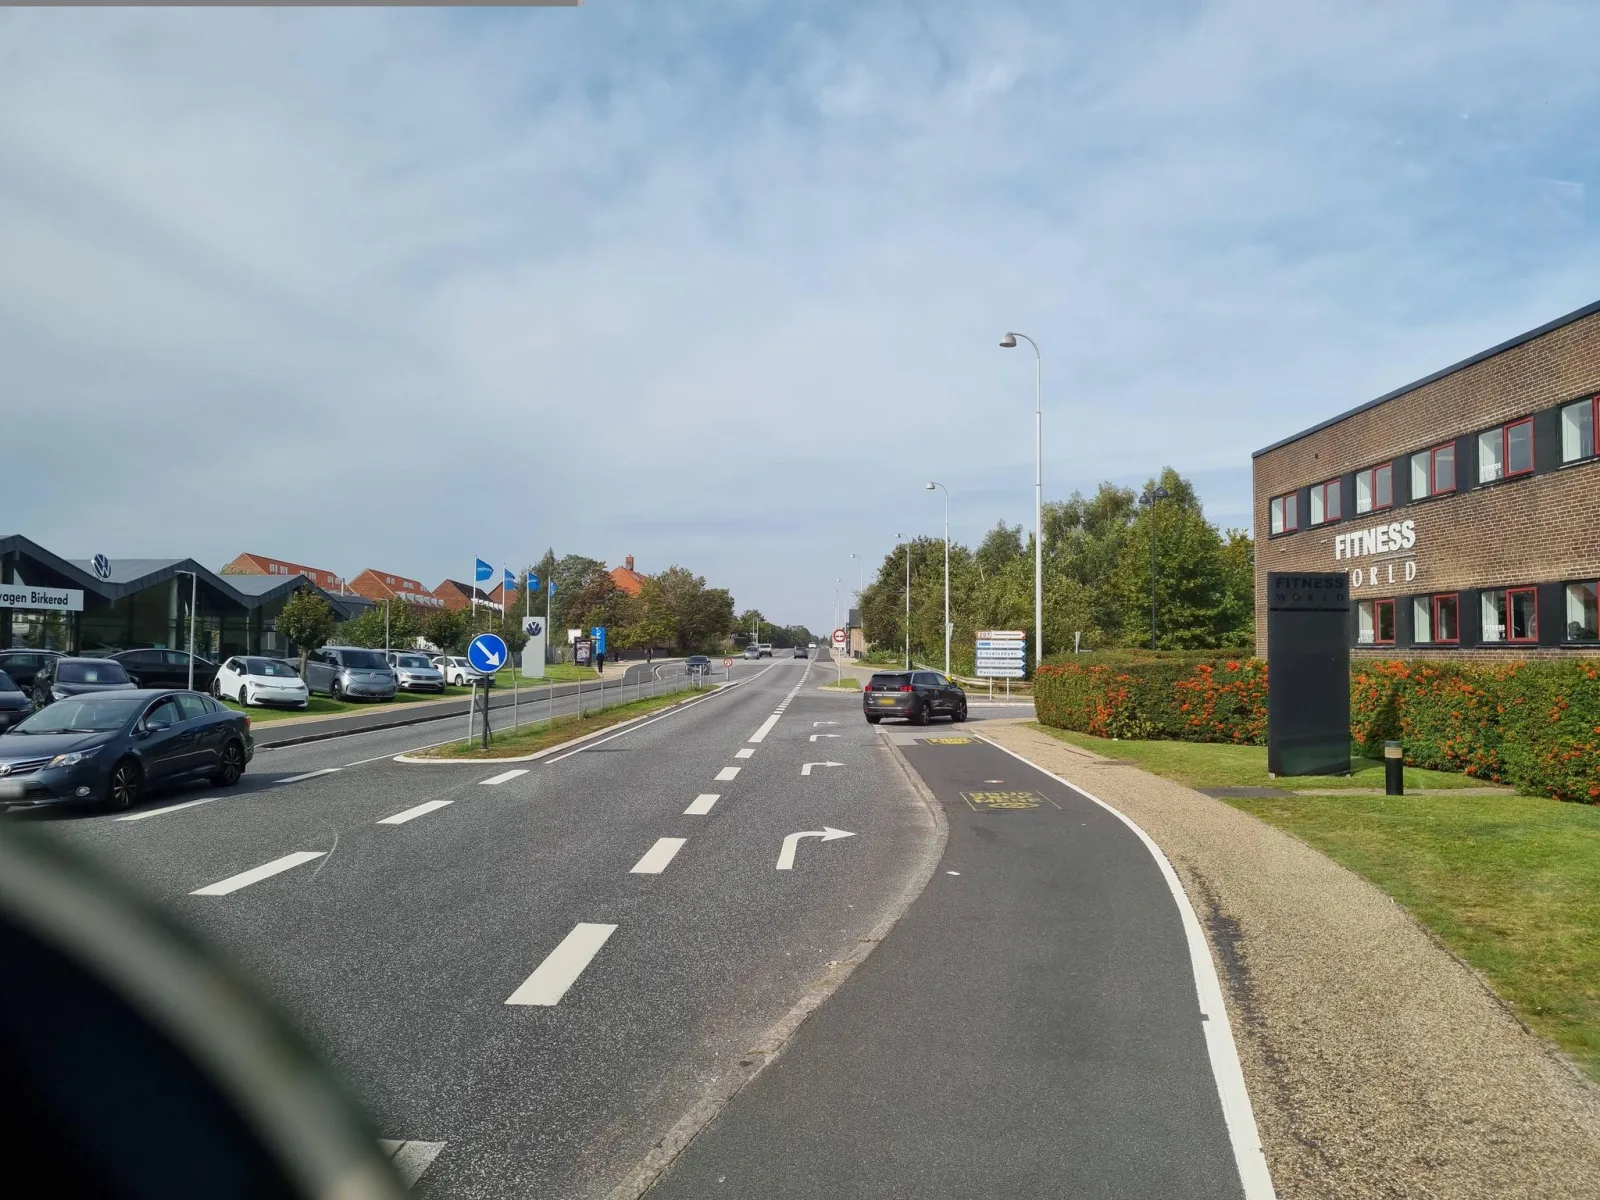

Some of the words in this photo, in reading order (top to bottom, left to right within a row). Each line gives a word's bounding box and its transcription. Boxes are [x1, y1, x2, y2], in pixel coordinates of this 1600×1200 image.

[1335, 519, 1416, 560] FITNESS
[1346, 561, 1416, 588] ORLD
[1276, 577, 1343, 589] FITNESS
[31, 591, 69, 606] Birkerød
[1276, 593, 1344, 601] WORLD
